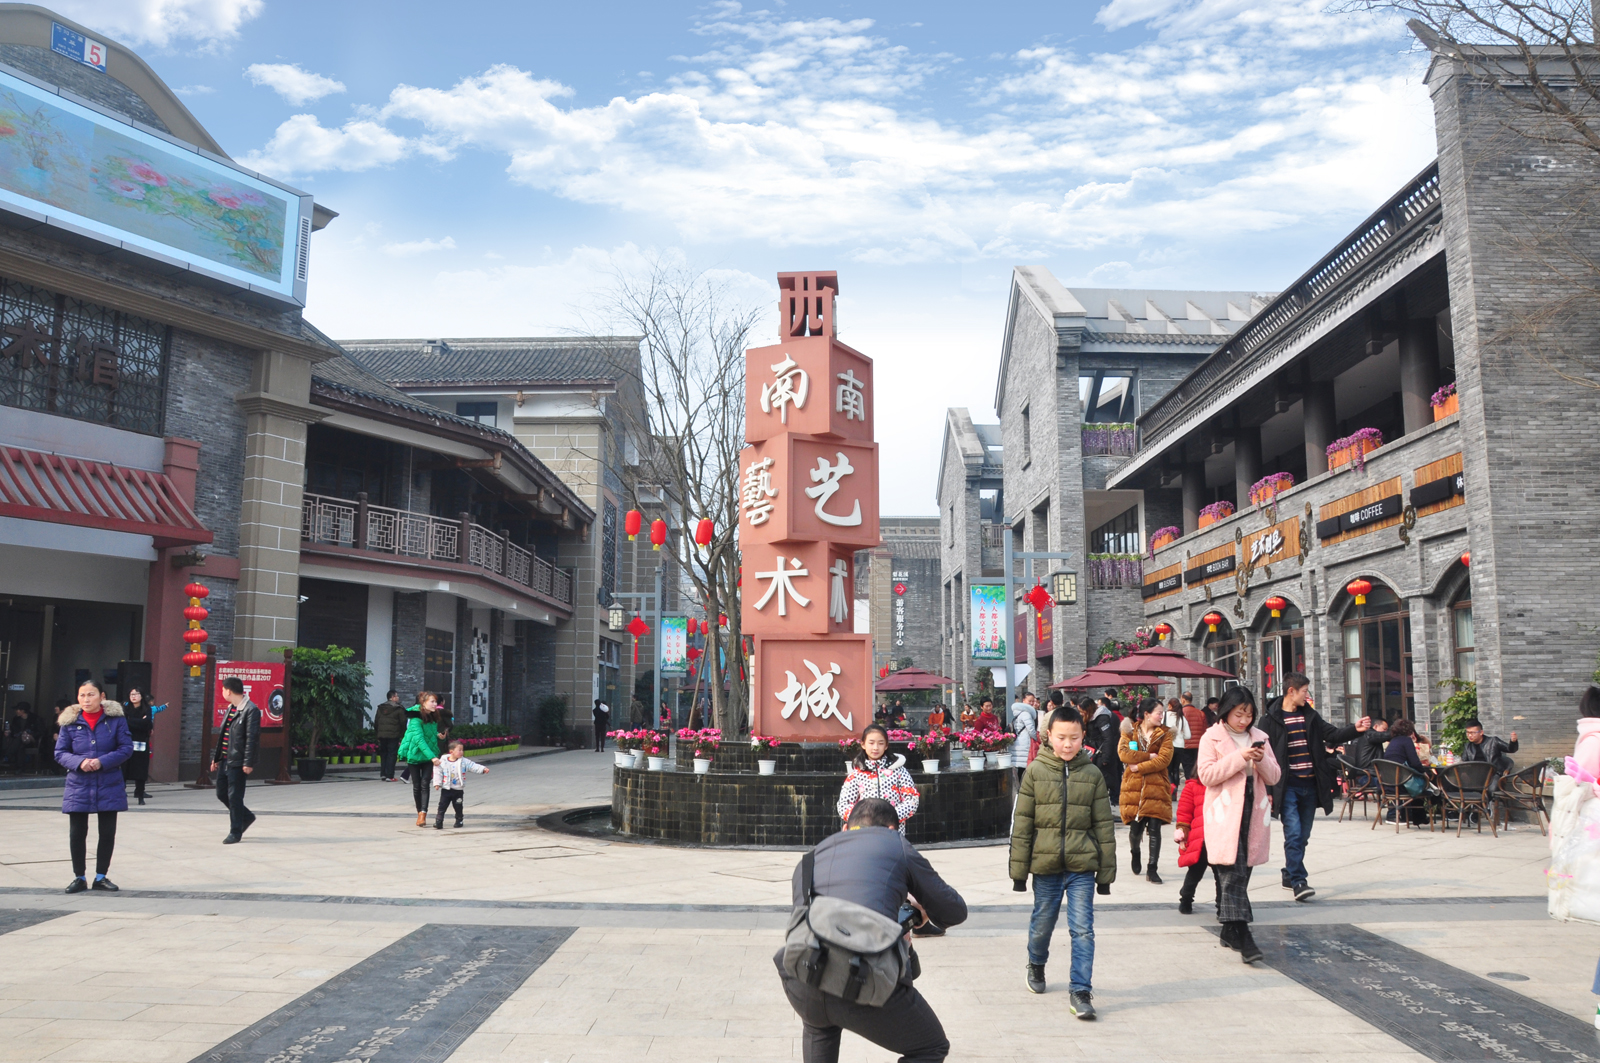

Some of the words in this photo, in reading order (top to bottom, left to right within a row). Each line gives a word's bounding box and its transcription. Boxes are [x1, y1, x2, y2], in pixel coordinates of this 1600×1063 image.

[89, 44, 101, 66] 5
[1360, 503, 1384, 521] COFFEE
[896, 598, 905, 646] 游客服务中心
